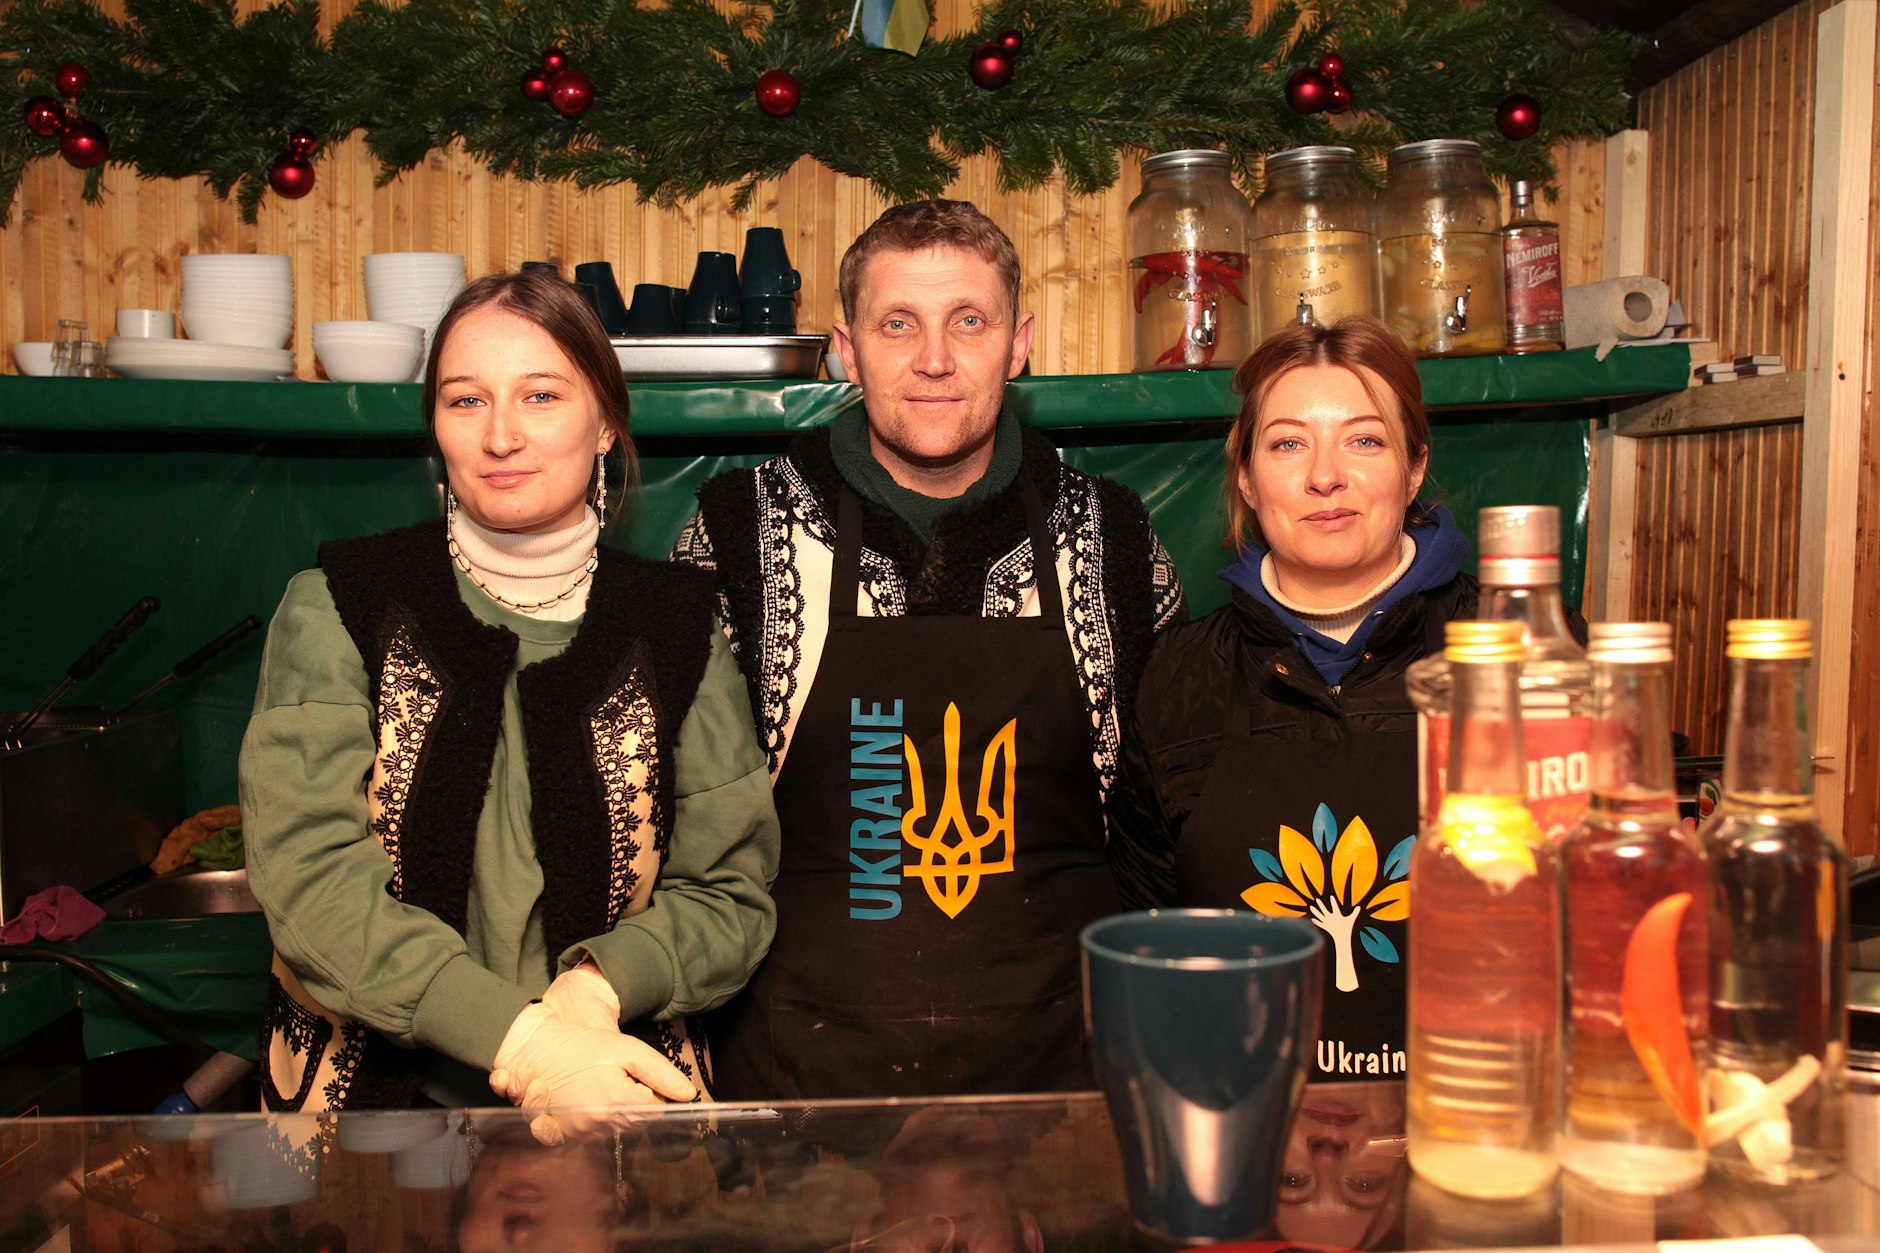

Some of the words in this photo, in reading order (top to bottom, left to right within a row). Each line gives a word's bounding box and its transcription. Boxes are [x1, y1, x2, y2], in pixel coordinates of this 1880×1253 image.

[1506, 242, 1559, 269] NEMIROFF
[1521, 261, 1558, 288] Vodka
[850, 698, 903, 921] UKRAINE
[1317, 1040, 1407, 1075] Ukrain
